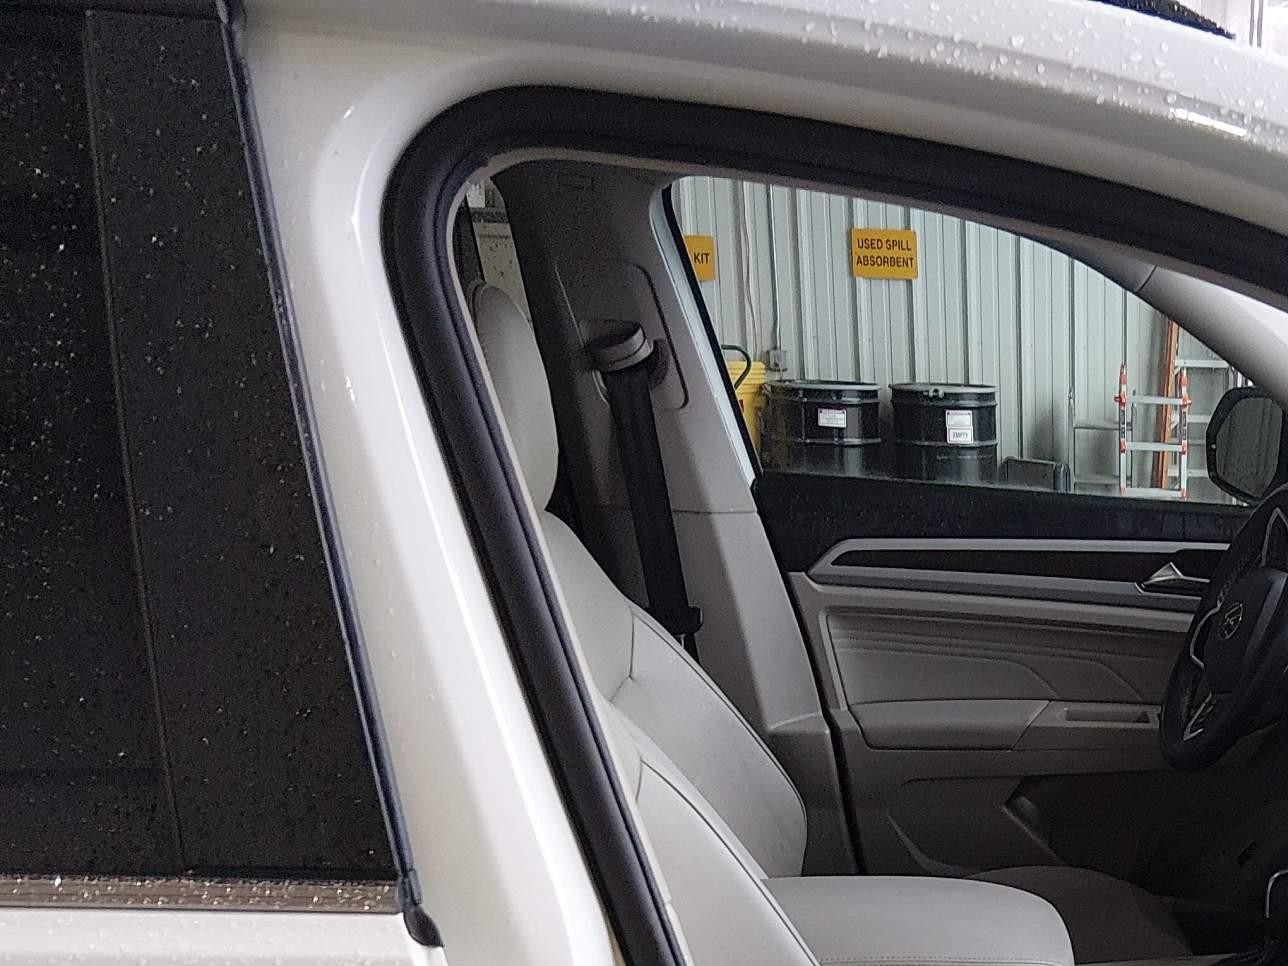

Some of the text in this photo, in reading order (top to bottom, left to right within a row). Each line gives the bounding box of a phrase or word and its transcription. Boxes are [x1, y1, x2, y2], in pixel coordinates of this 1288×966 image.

[857, 237, 912, 251] USED SPILL
[693, 252, 710, 265] KIT
[856, 254, 914, 268] ABSORBENT
